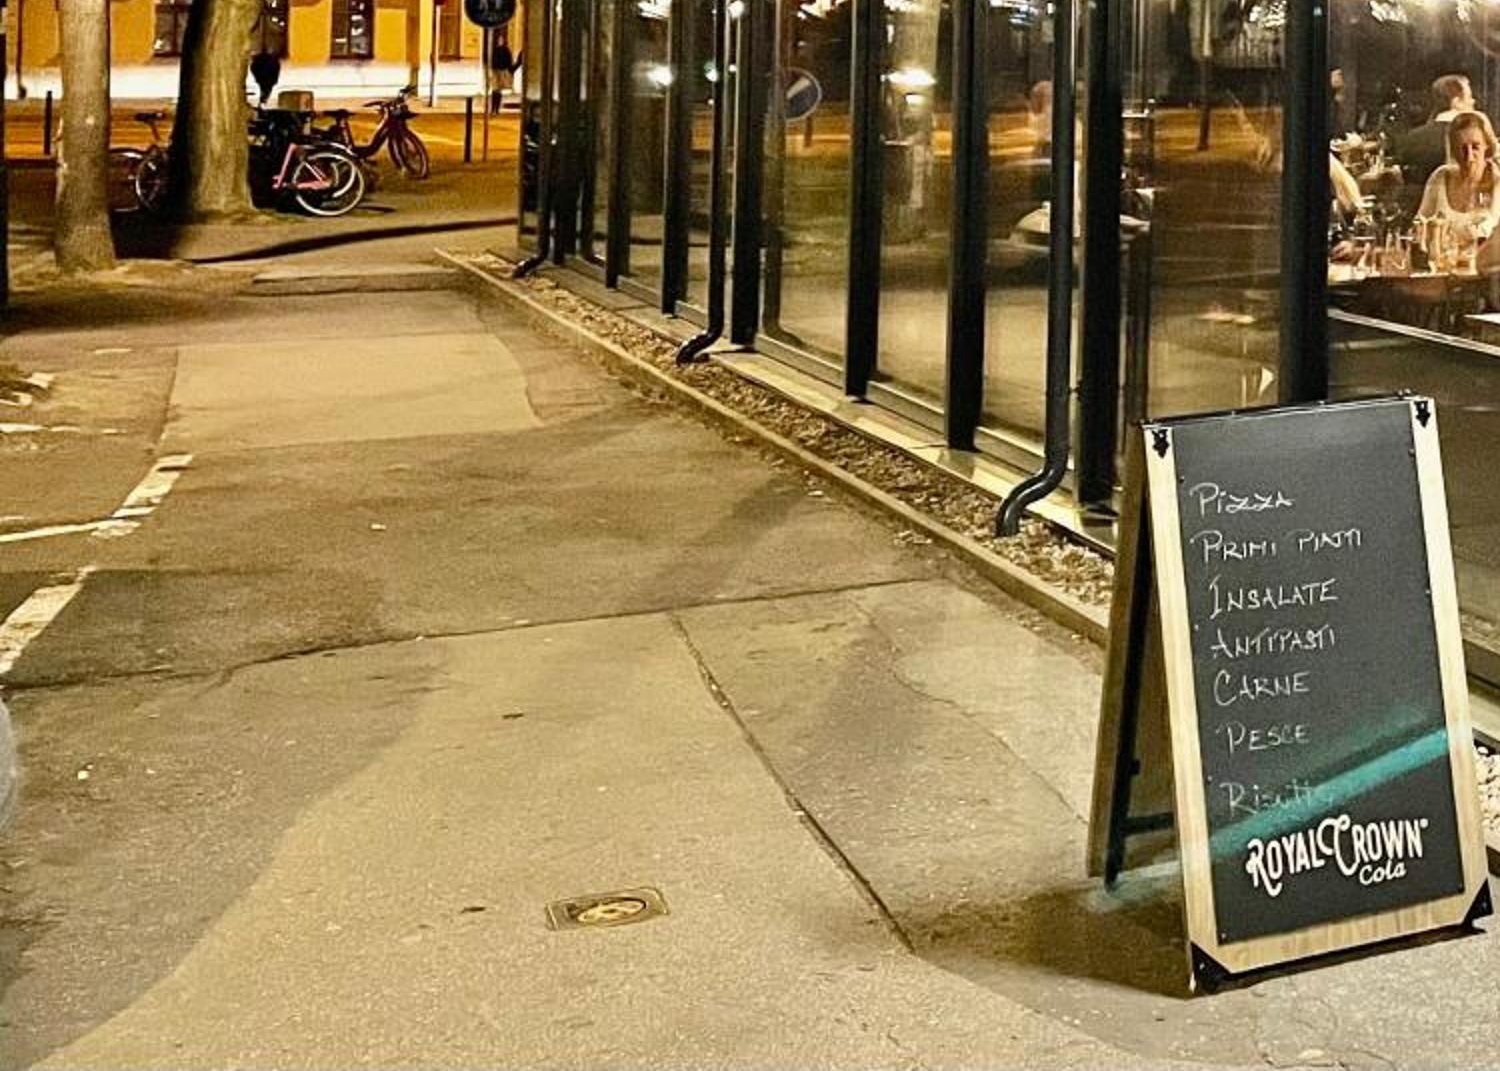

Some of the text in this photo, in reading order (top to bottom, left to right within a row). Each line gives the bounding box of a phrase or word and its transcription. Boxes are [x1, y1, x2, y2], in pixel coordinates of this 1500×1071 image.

[1246, 814, 1428, 897] ROYAL CROWN
[1359, 859, 1407, 885] Cola
